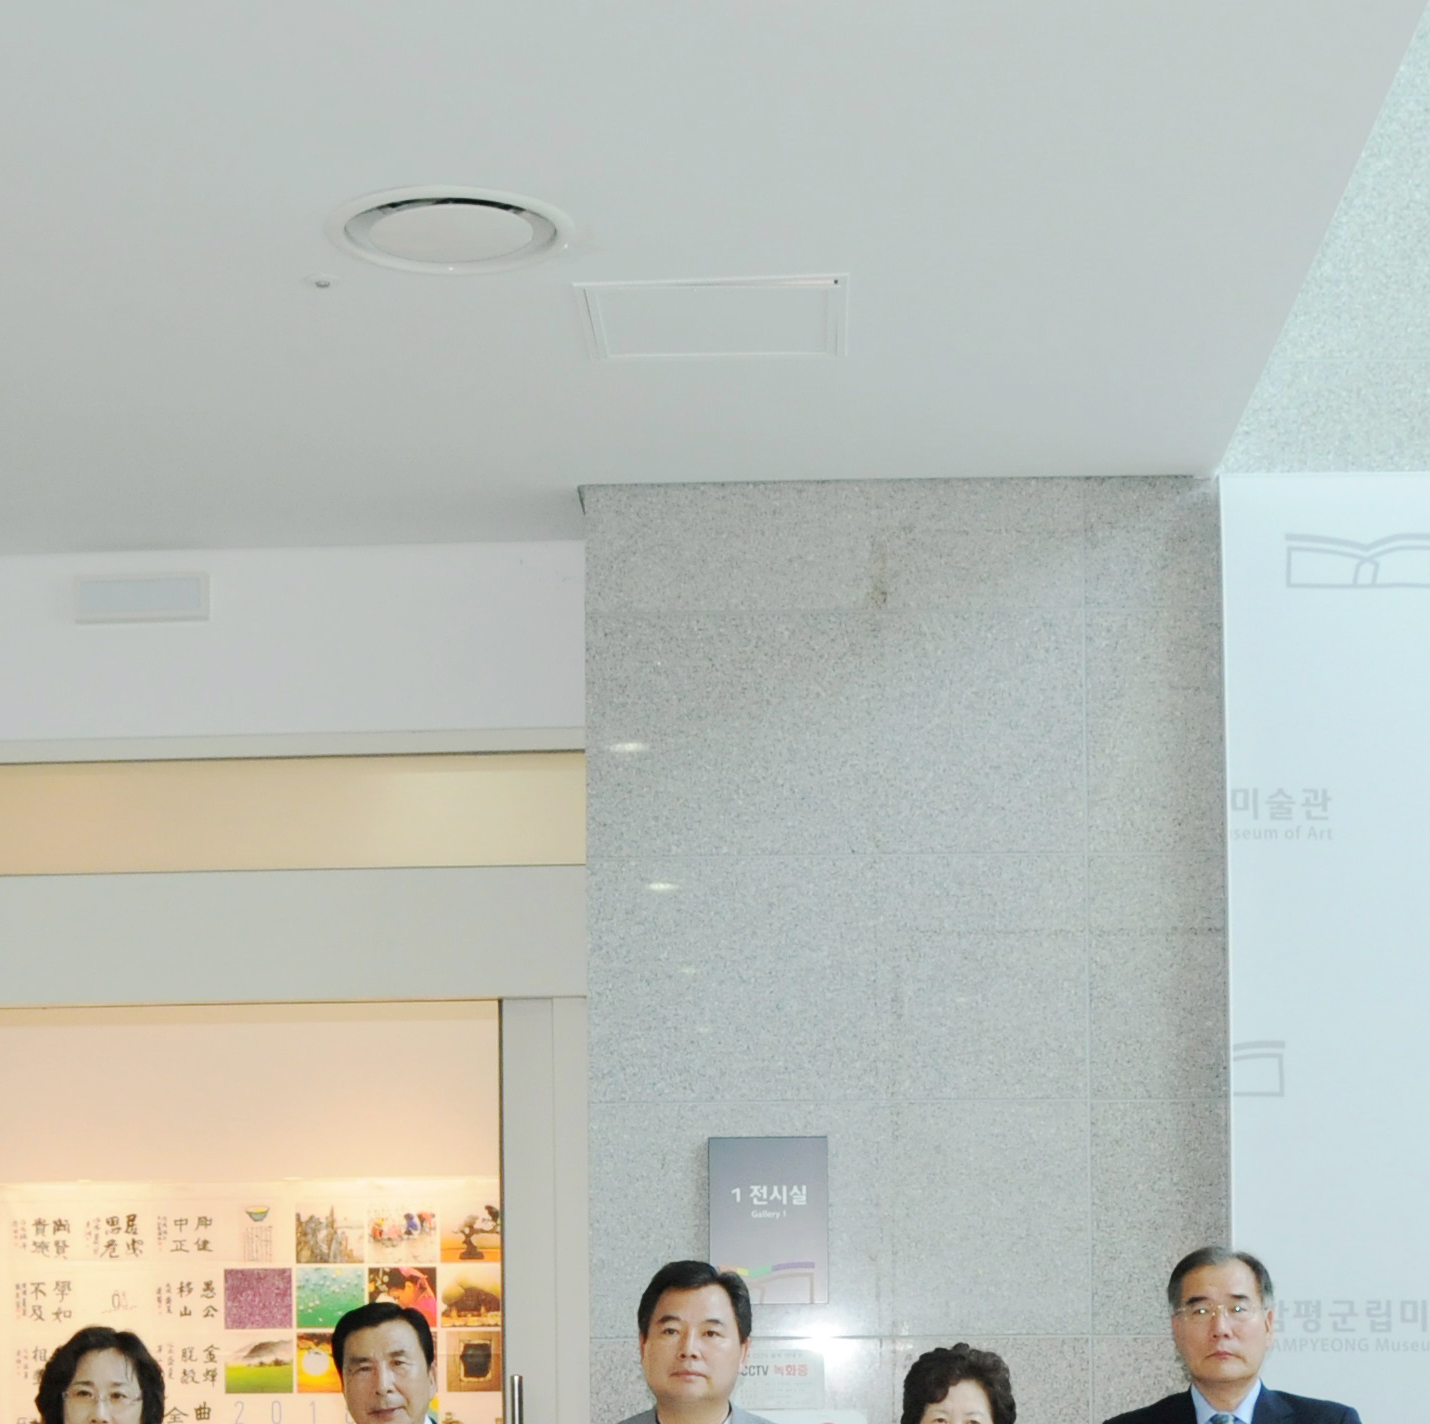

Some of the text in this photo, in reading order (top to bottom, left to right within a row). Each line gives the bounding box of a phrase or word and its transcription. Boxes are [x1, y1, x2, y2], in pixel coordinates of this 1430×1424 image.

[1284, 825, 1302, 840] of
[1307, 826, 1333, 840] Art
[731, 1185, 807, 1206] 1 전시실
[751, 1210, 780, 1219] Gallery
[1273, 1337, 1369, 1352] AMPYEONG
[741, 1365, 769, 1376] CCTV
[164, 1406, 189, 1424] 全
